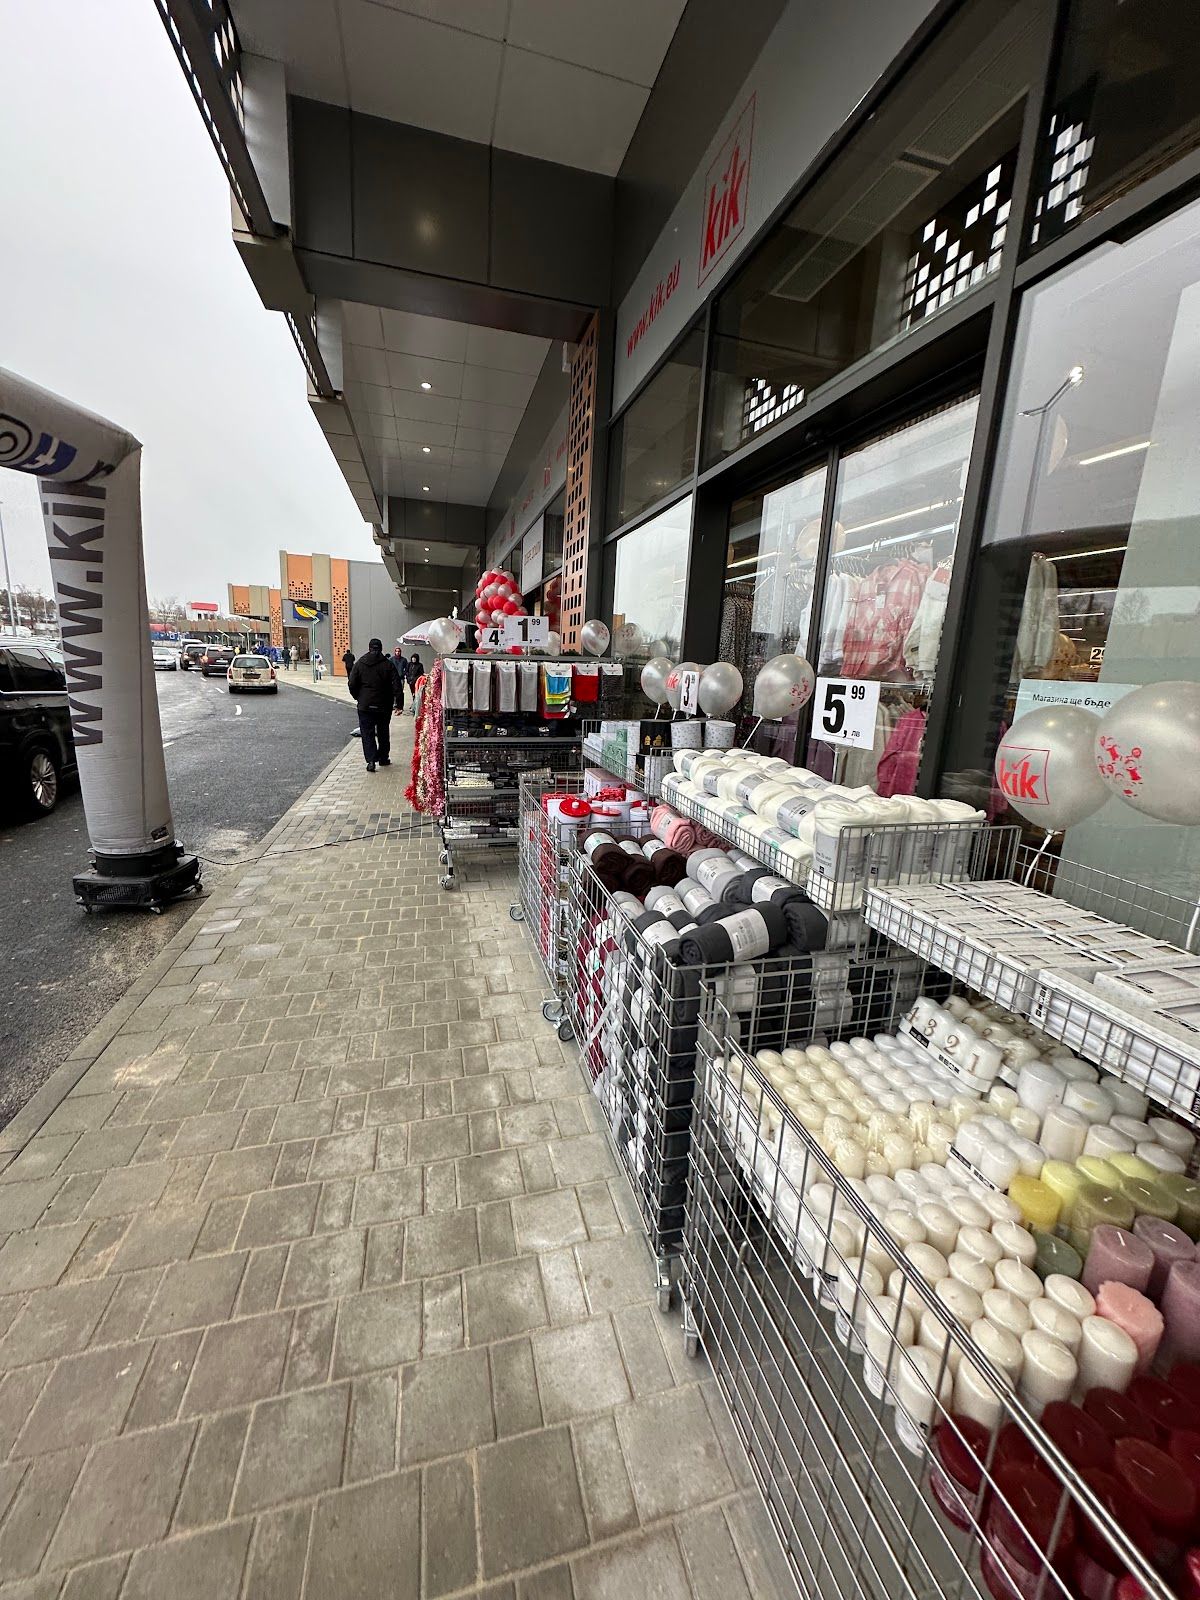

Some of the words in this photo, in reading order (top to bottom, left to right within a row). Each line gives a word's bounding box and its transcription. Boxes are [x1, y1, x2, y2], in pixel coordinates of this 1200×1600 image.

[703, 135, 746, 270] kik
[627, 259, 681, 359] www.kik.eu
[851, 685, 865, 700] 99
[1032, 693, 1069, 704] Магазина
[1069, 698, 1083, 706] ще
[1084, 697, 1111, 709] бъде
[1000, 753, 1040, 800] kik
[924, 1018, 938, 1037] 3
[943, 1034, 961, 1055] 2
[967, 1053, 980, 1076] 1
